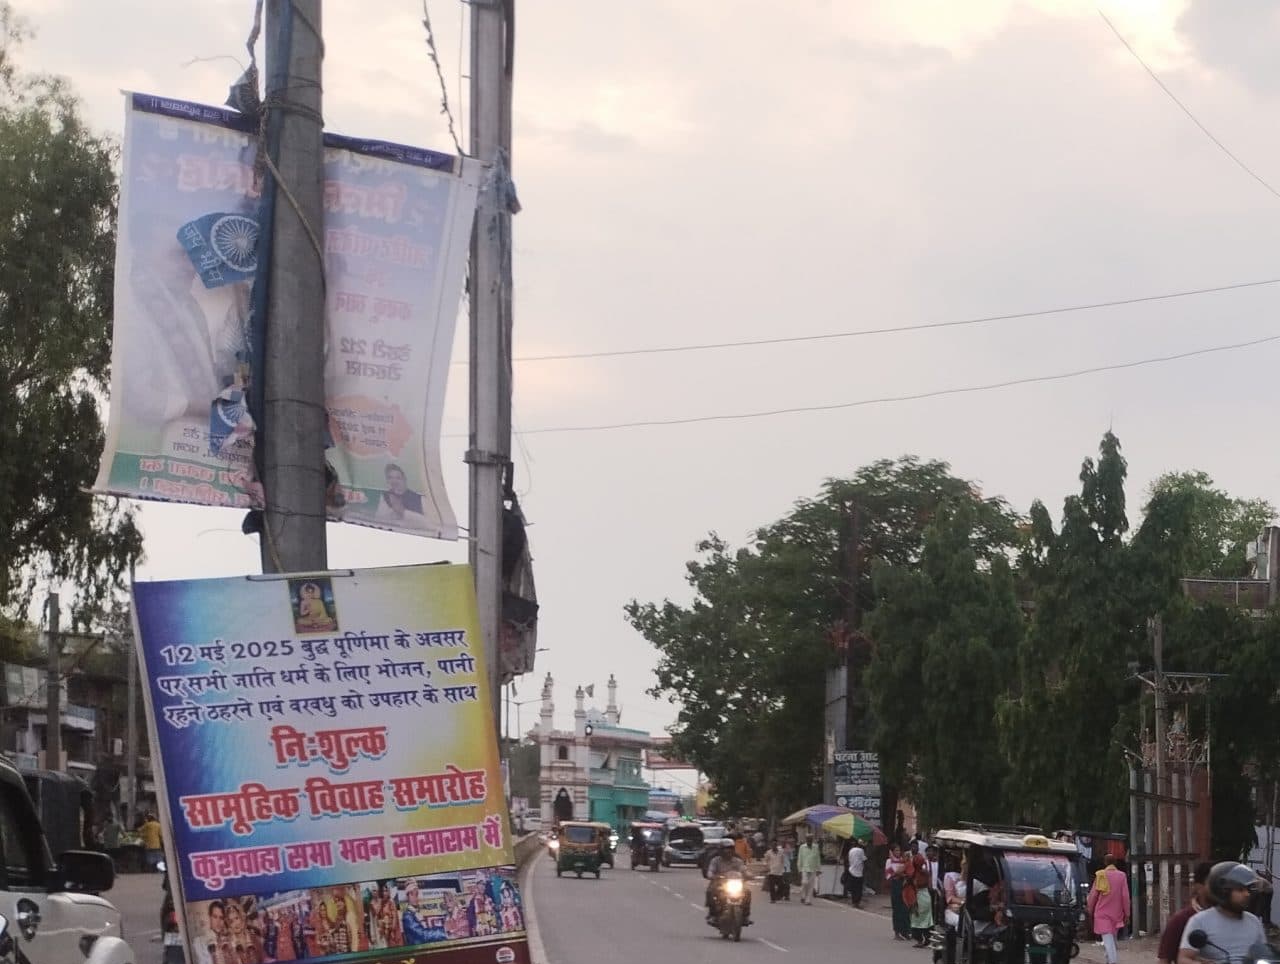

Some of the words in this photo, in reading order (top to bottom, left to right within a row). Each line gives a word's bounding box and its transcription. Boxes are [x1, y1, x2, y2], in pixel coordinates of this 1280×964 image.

[162, 645, 195, 665] 12
[200, 640, 225, 664] मई
[231, 639, 295, 660] 2025
[300, 638, 329, 661] बुद्ध
[334, 631, 389, 658] पूर्णिमा
[394, 629, 411, 649] के
[416, 629, 468, 648] अवसर
[160, 677, 187, 697] पर
[188, 671, 229, 693] सभी
[233, 668, 276, 690] जाति
[281, 665, 310, 684] धर्म
[314, 662, 331, 683] के
[336, 661, 371, 685] लिए
[376, 659, 432, 679] भोजन,
[437, 653, 475, 674] पानी
[165, 702, 201, 728] रहने
[206, 699, 254, 723] ठहरने
[258, 695, 284, 721] एवं
[289, 696, 337, 717] वरवधु
[341, 690, 365, 711] को
[369, 689, 419, 708] उपहार
[423, 685, 439, 703] के
[444, 684, 478, 702] साथ
[181, 782, 300, 834] सामूहिक
[304, 776, 385, 818] विवाह
[389, 764, 487, 810] समारोह
[189, 846, 281, 890] कुशवाहा
[338, 836, 387, 863] भवन
[391, 825, 479, 858] सासाराम
[481, 815, 503, 849] में
